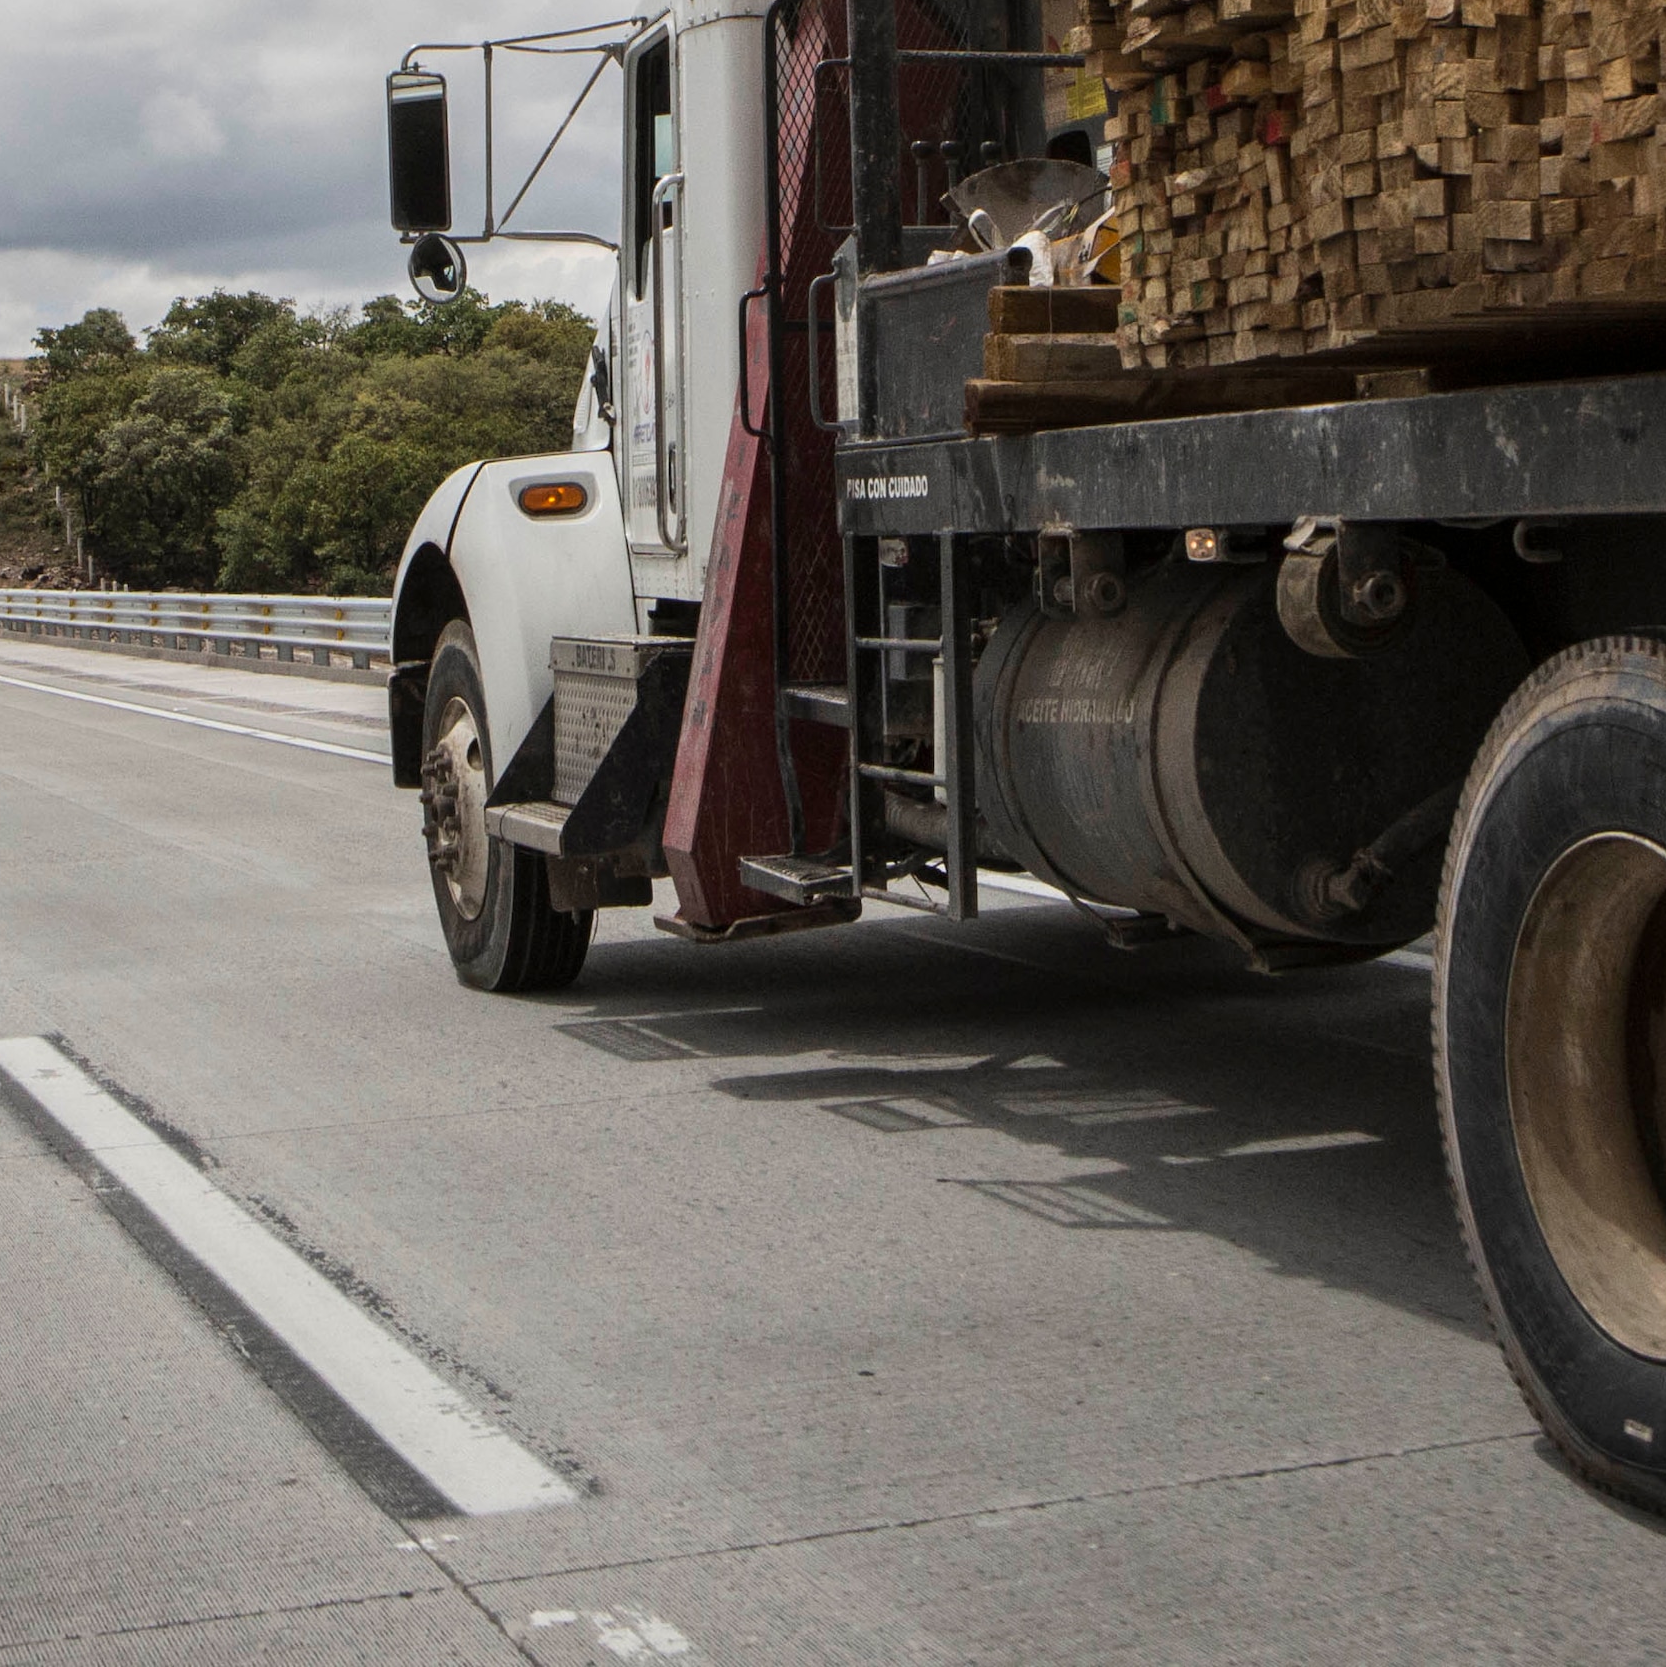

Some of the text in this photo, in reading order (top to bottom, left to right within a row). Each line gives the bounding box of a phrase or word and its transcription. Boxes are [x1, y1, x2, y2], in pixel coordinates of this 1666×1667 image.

[846, 475, 929, 499] PISA CON CUIDADO
[576, 644, 616, 672] BATERIS
[1017, 698, 1059, 723] ACEITE
